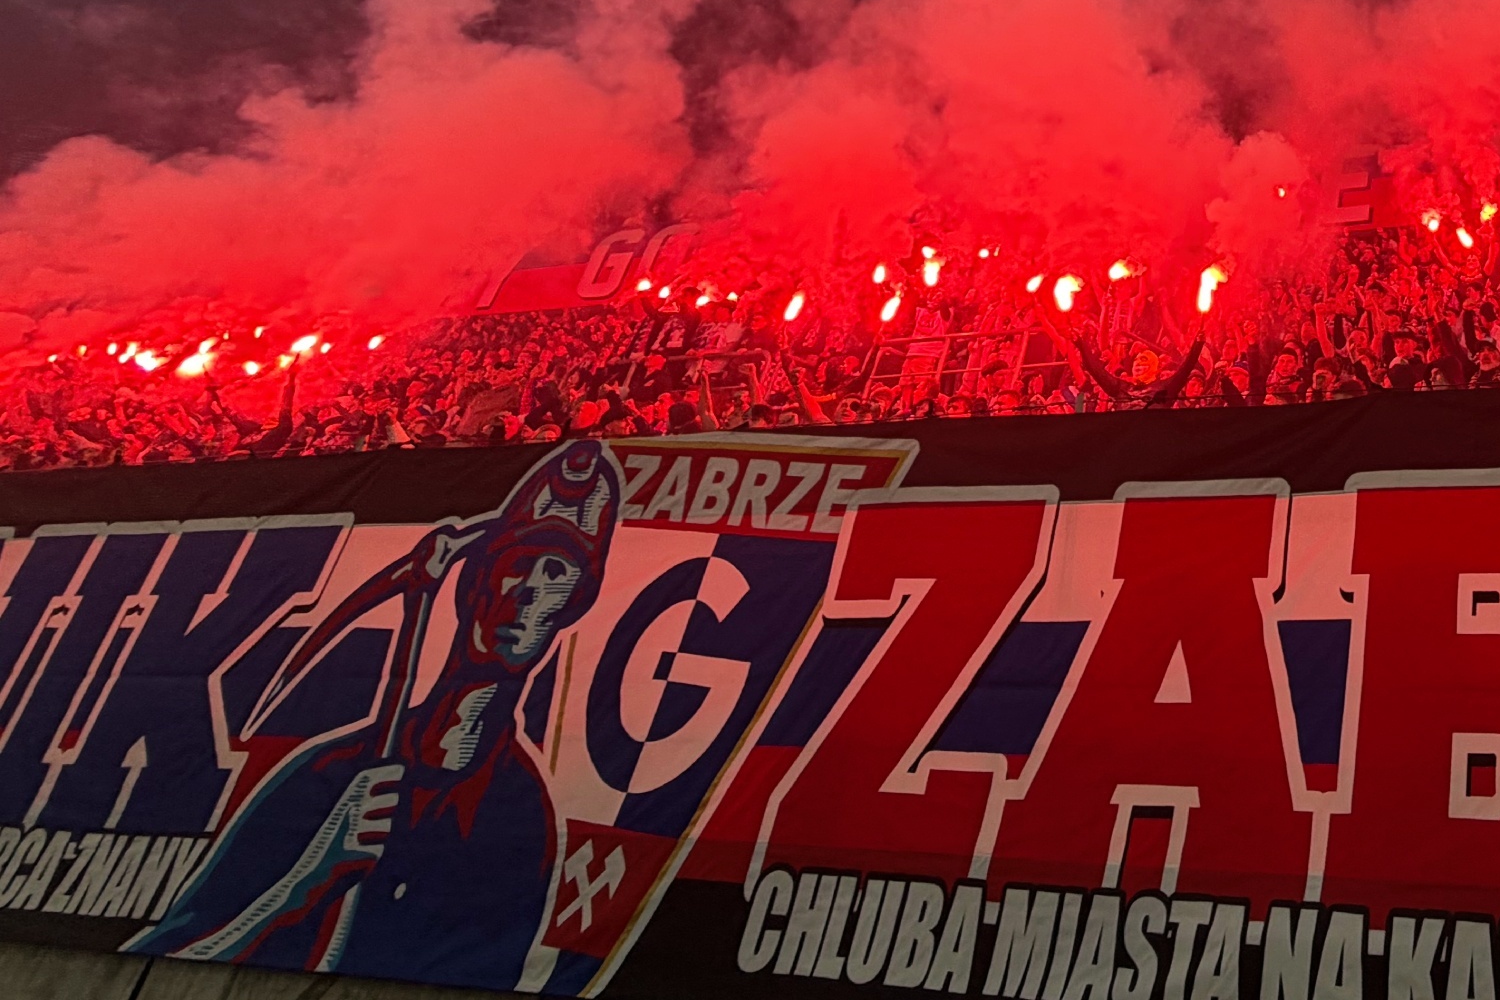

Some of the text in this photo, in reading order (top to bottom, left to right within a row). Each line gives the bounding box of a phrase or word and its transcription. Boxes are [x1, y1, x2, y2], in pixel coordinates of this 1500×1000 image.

[620, 455, 867, 534] ZABRZE
[0, 826, 211, 921] CA ZNANY
[737, 869, 984, 993] CHLUBA
[983, 888, 1246, 1000] MIASTA
[1259, 906, 1365, 1000] NA
